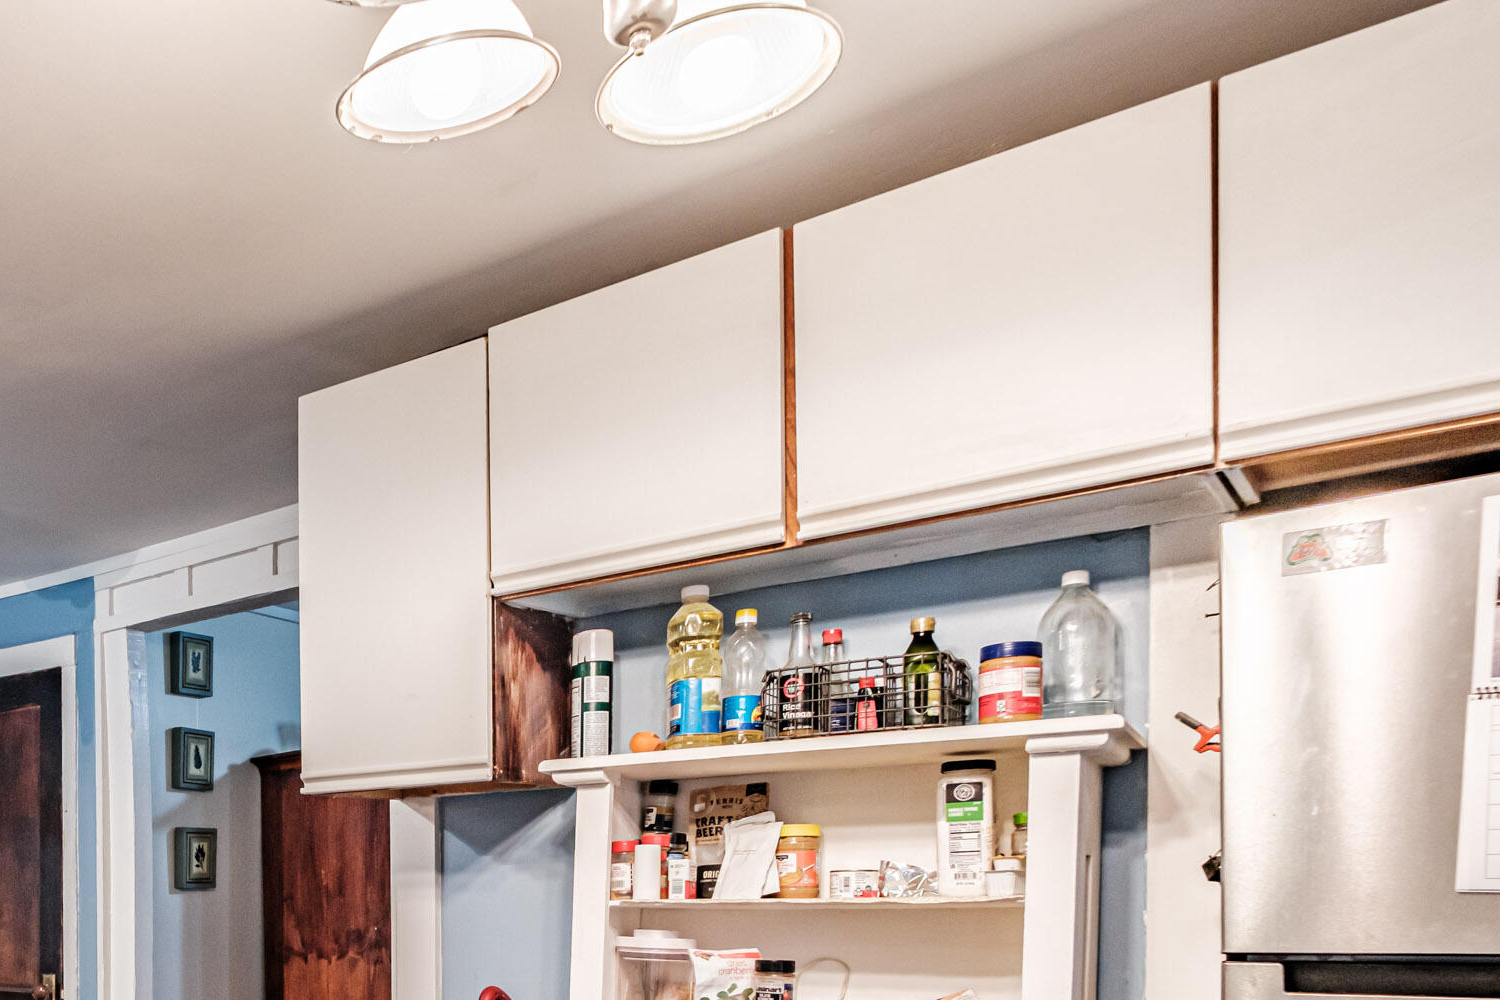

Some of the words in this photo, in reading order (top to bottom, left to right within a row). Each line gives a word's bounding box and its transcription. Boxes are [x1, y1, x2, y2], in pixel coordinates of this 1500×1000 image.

[782, 702, 801, 712] Rice
[695, 815, 734, 828] CRAFT
[695, 826, 724, 838] BEER
